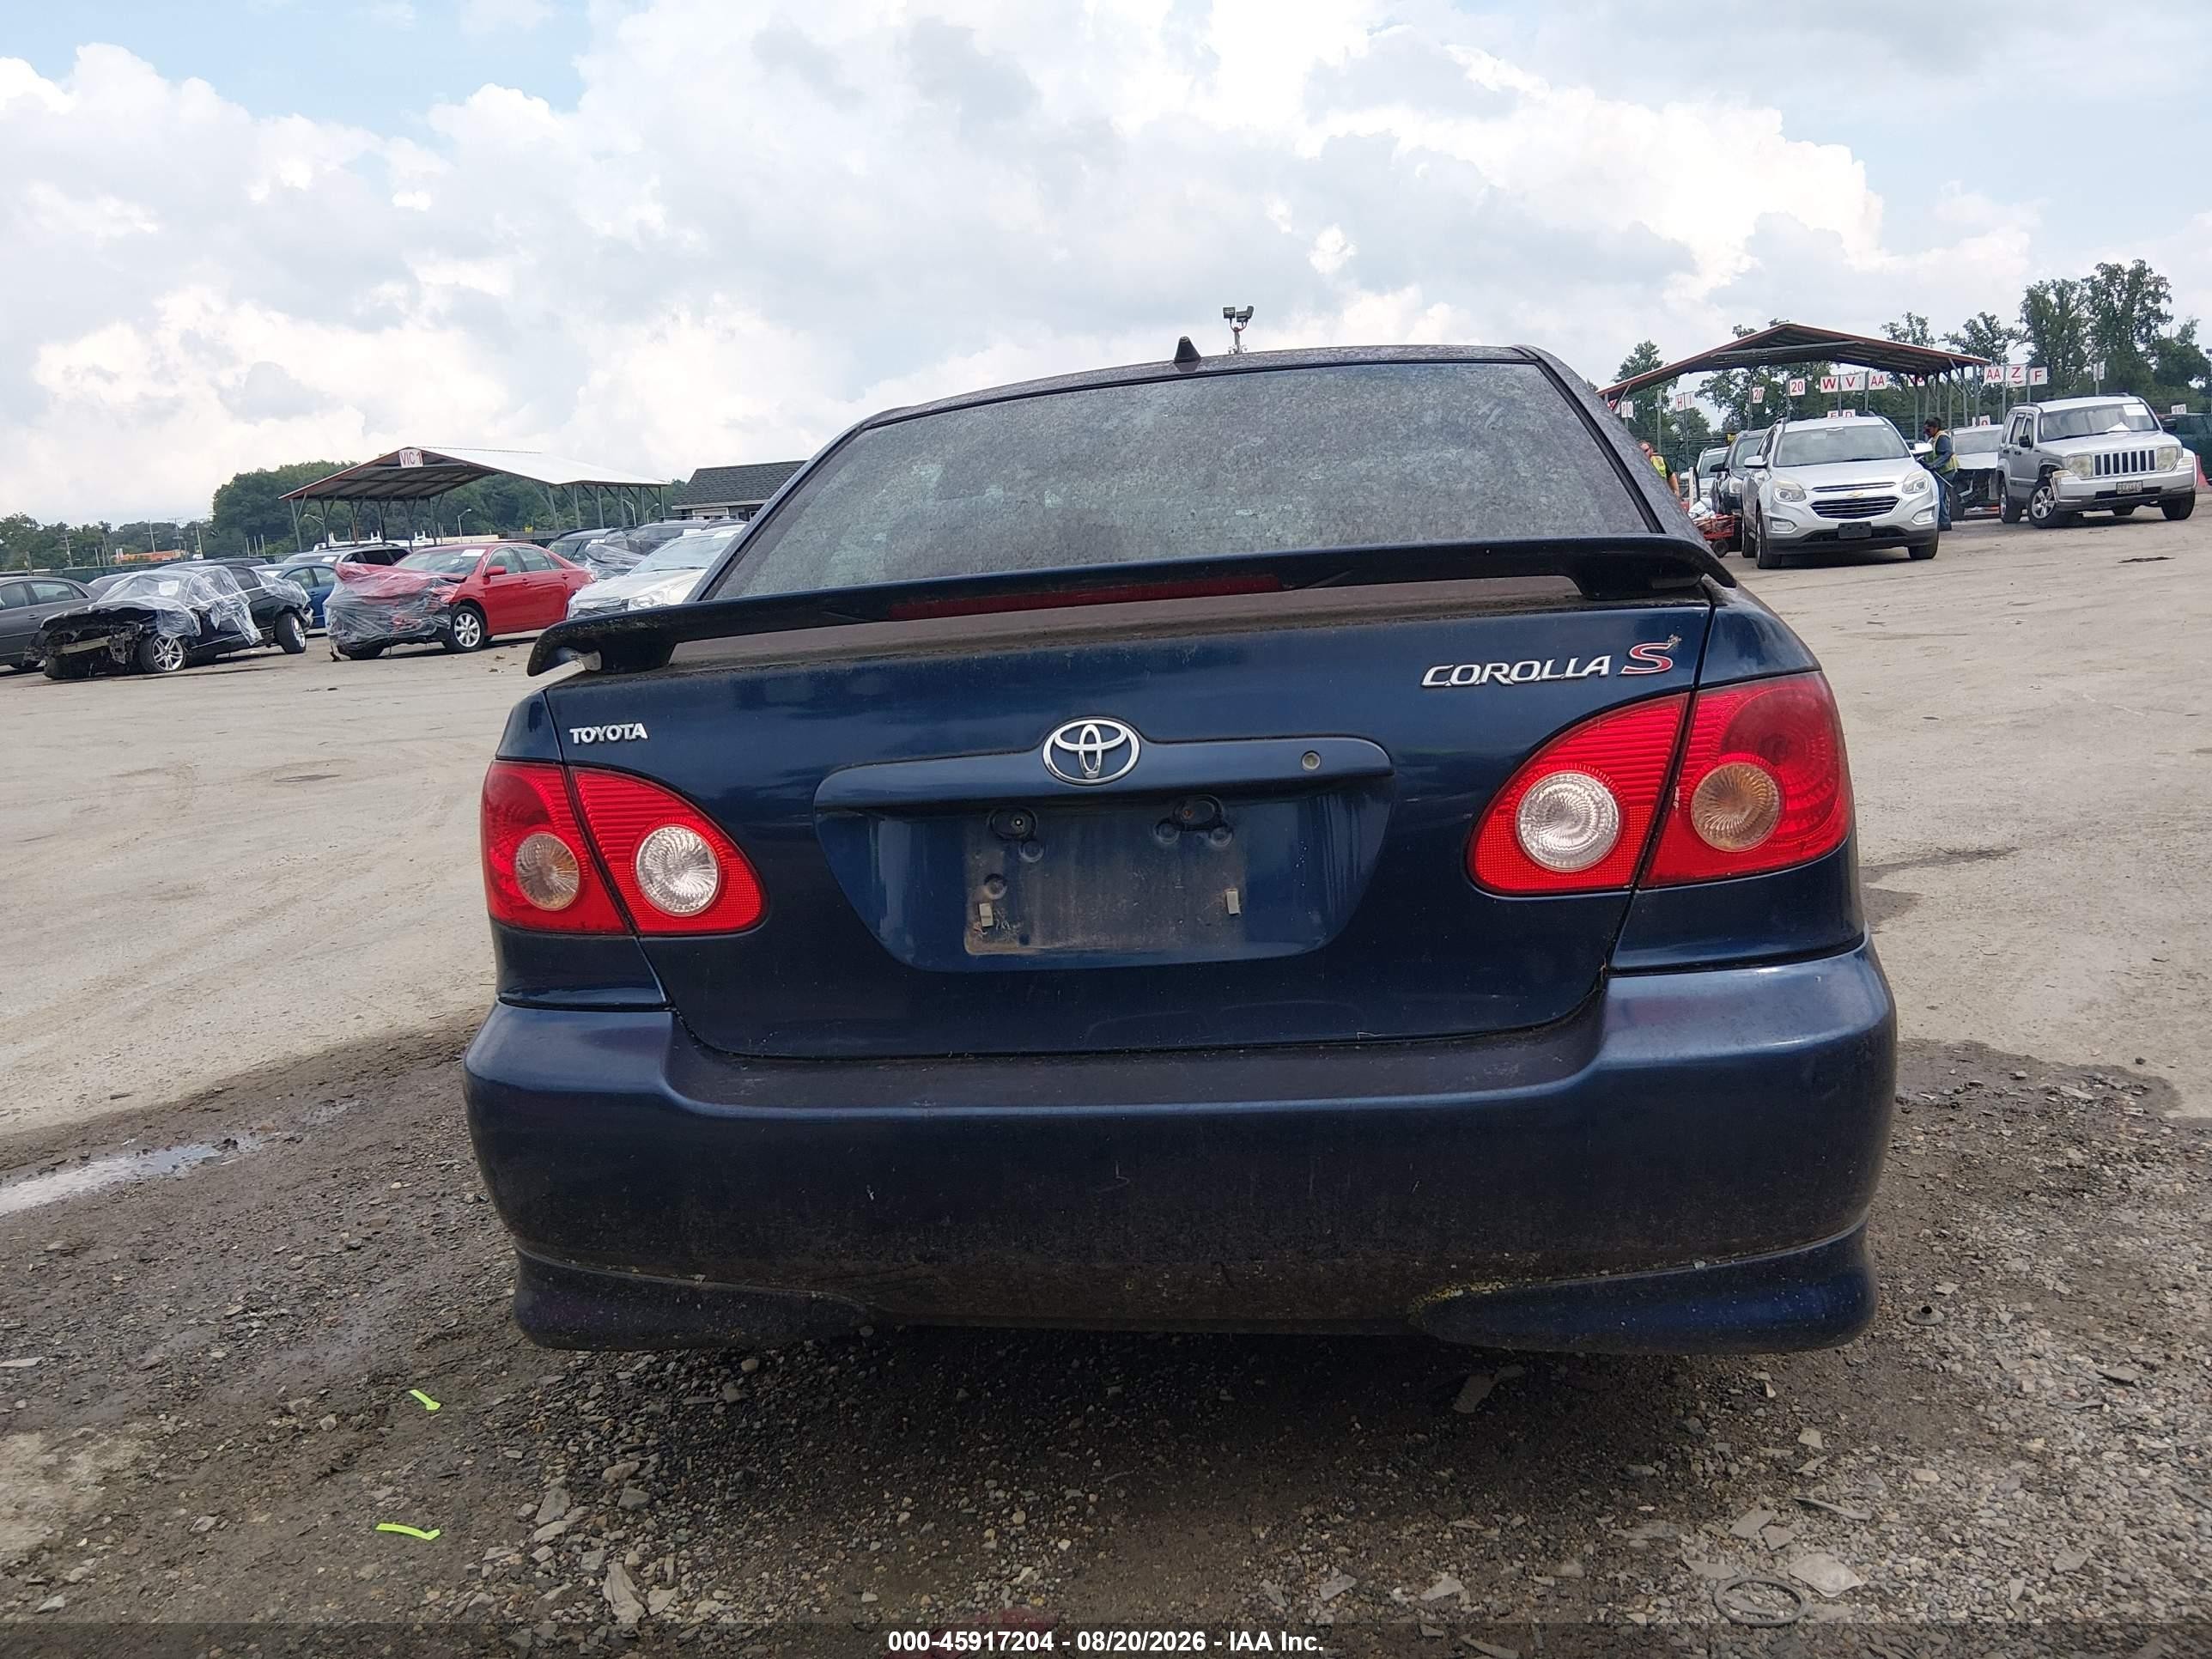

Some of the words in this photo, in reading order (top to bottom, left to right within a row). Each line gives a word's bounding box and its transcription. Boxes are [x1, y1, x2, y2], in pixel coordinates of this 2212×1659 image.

[1986, 368, 2001, 380] AA
[2011, 367, 2021, 379] Z
[2034, 370, 2043, 382] F
[1791, 380, 1803, 392] 20
[1822, 378, 1837, 390] W
[1845, 376, 1856, 387] V
[1870, 374, 1885, 386] AA
[1753, 389, 1763, 400] 20
[1676, 397, 1683, 409] H
[400, 452, 416, 465] VIC
[1420, 654, 1612, 687] COROLLA
[1617, 641, 1674, 677] S
[569, 722, 649, 744] TOYOTA
